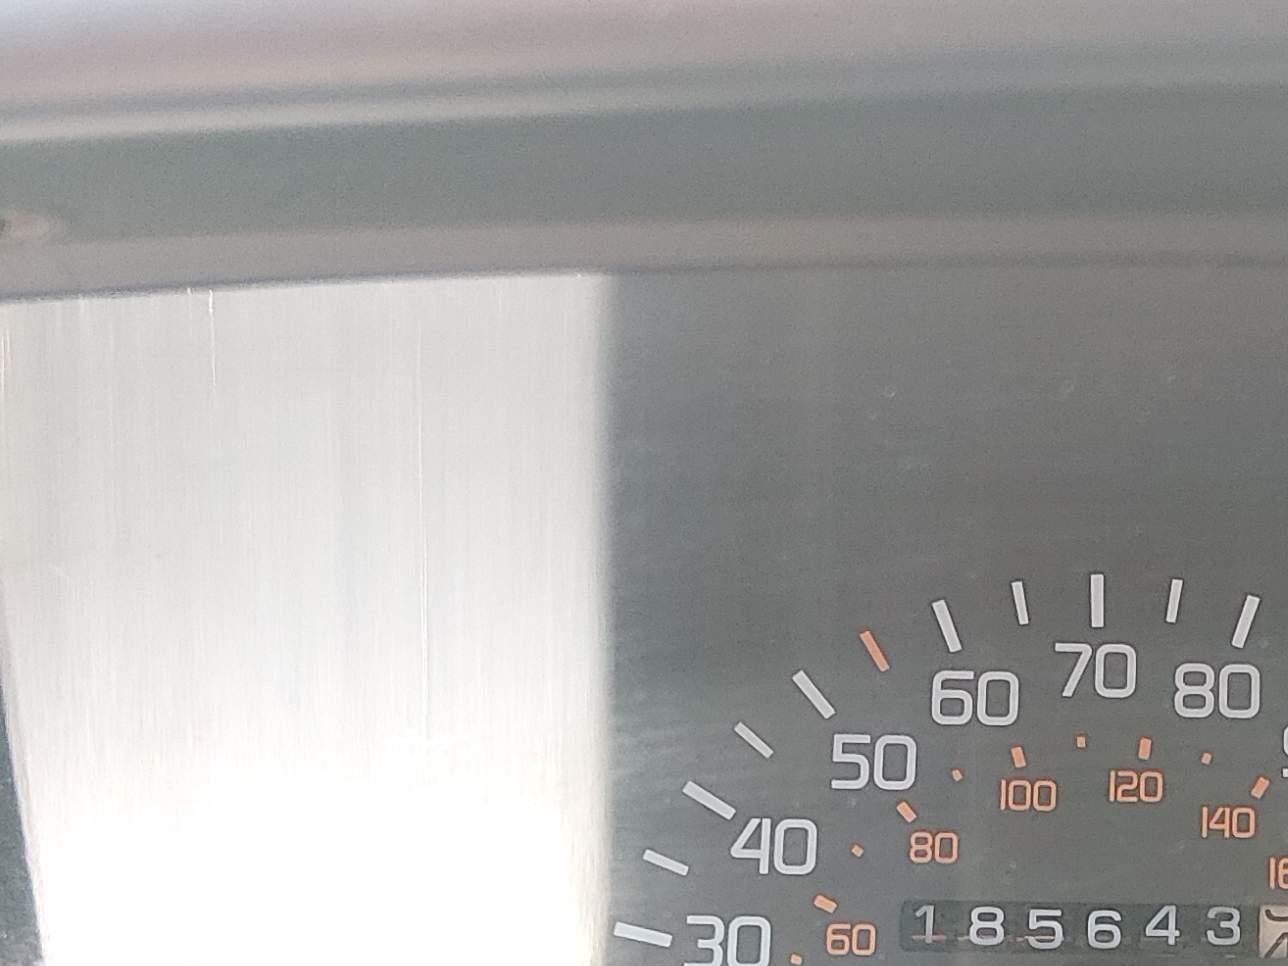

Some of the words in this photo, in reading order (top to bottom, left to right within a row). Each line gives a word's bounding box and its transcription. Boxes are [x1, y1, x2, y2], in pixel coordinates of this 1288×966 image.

[1054, 642, 1137, 698] 70
[1174, 663, 1260, 719] 80
[931, 670, 1019, 726] 60
[831, 733, 917, 791] 50
[1000, 779, 1057, 811] 100
[1109, 770, 1163, 802] 120
[1201, 806, 1256, 838] 140
[729, 816, 818, 876] 40
[909, 831, 958, 864] 80
[826, 923, 876, 956] 60
